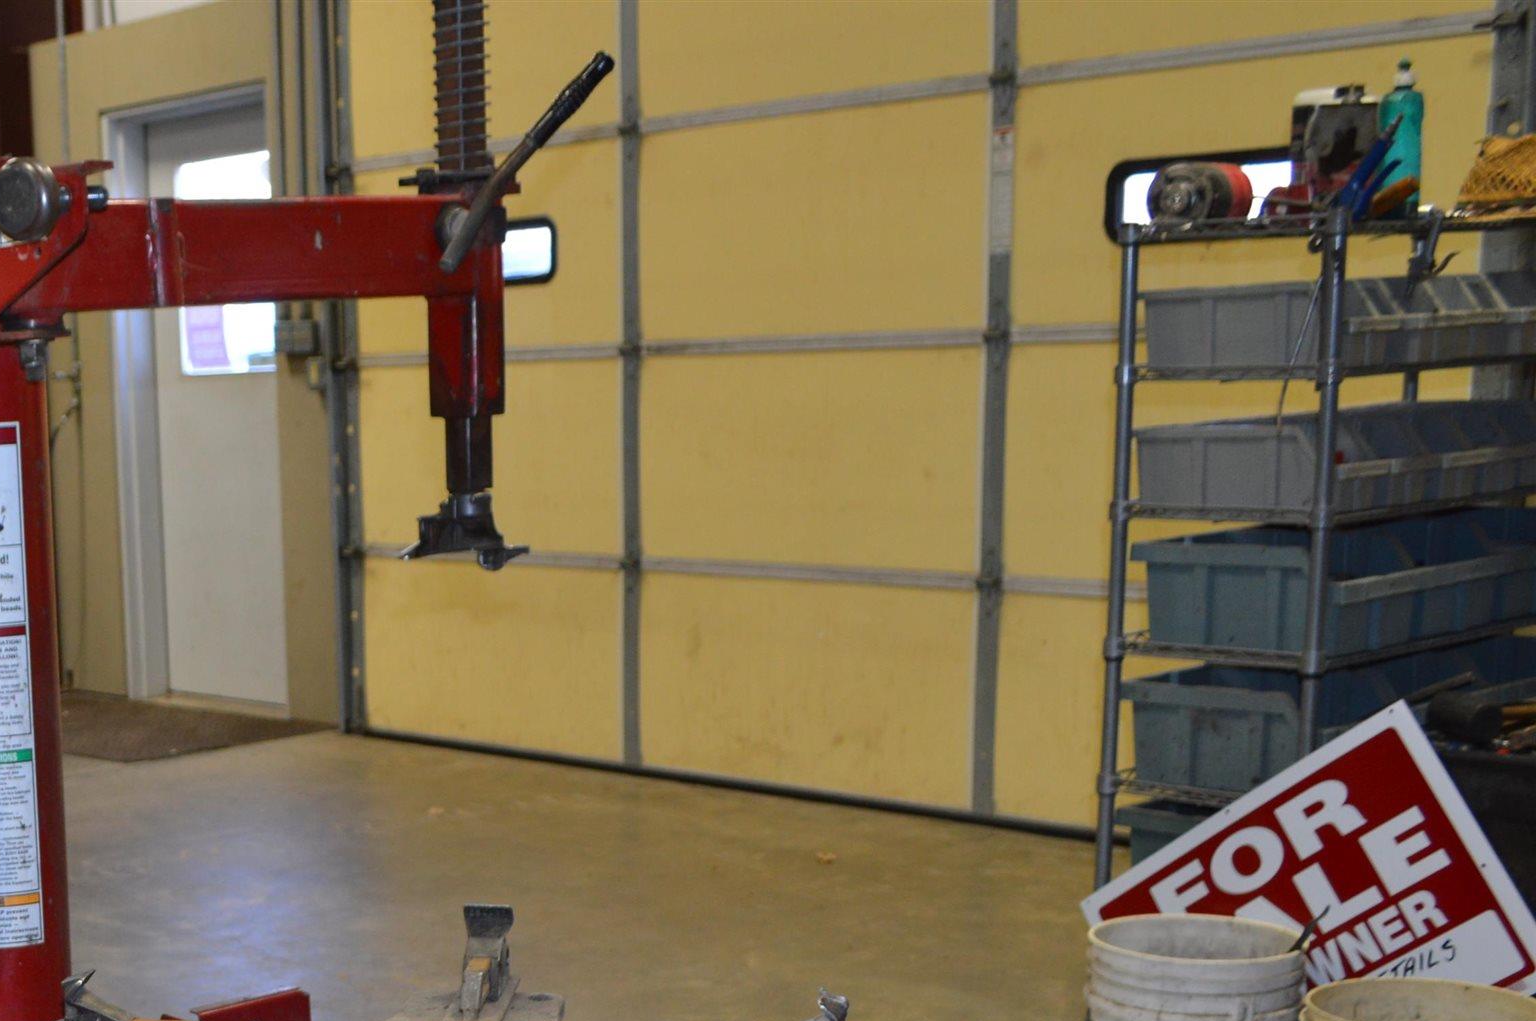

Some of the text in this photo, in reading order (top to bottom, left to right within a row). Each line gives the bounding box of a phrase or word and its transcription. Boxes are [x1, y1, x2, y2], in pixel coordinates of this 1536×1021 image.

[1149, 779, 1367, 914] FOR
[1305, 889, 1450, 987] WNER
[1378, 938, 1457, 978] TAILS
